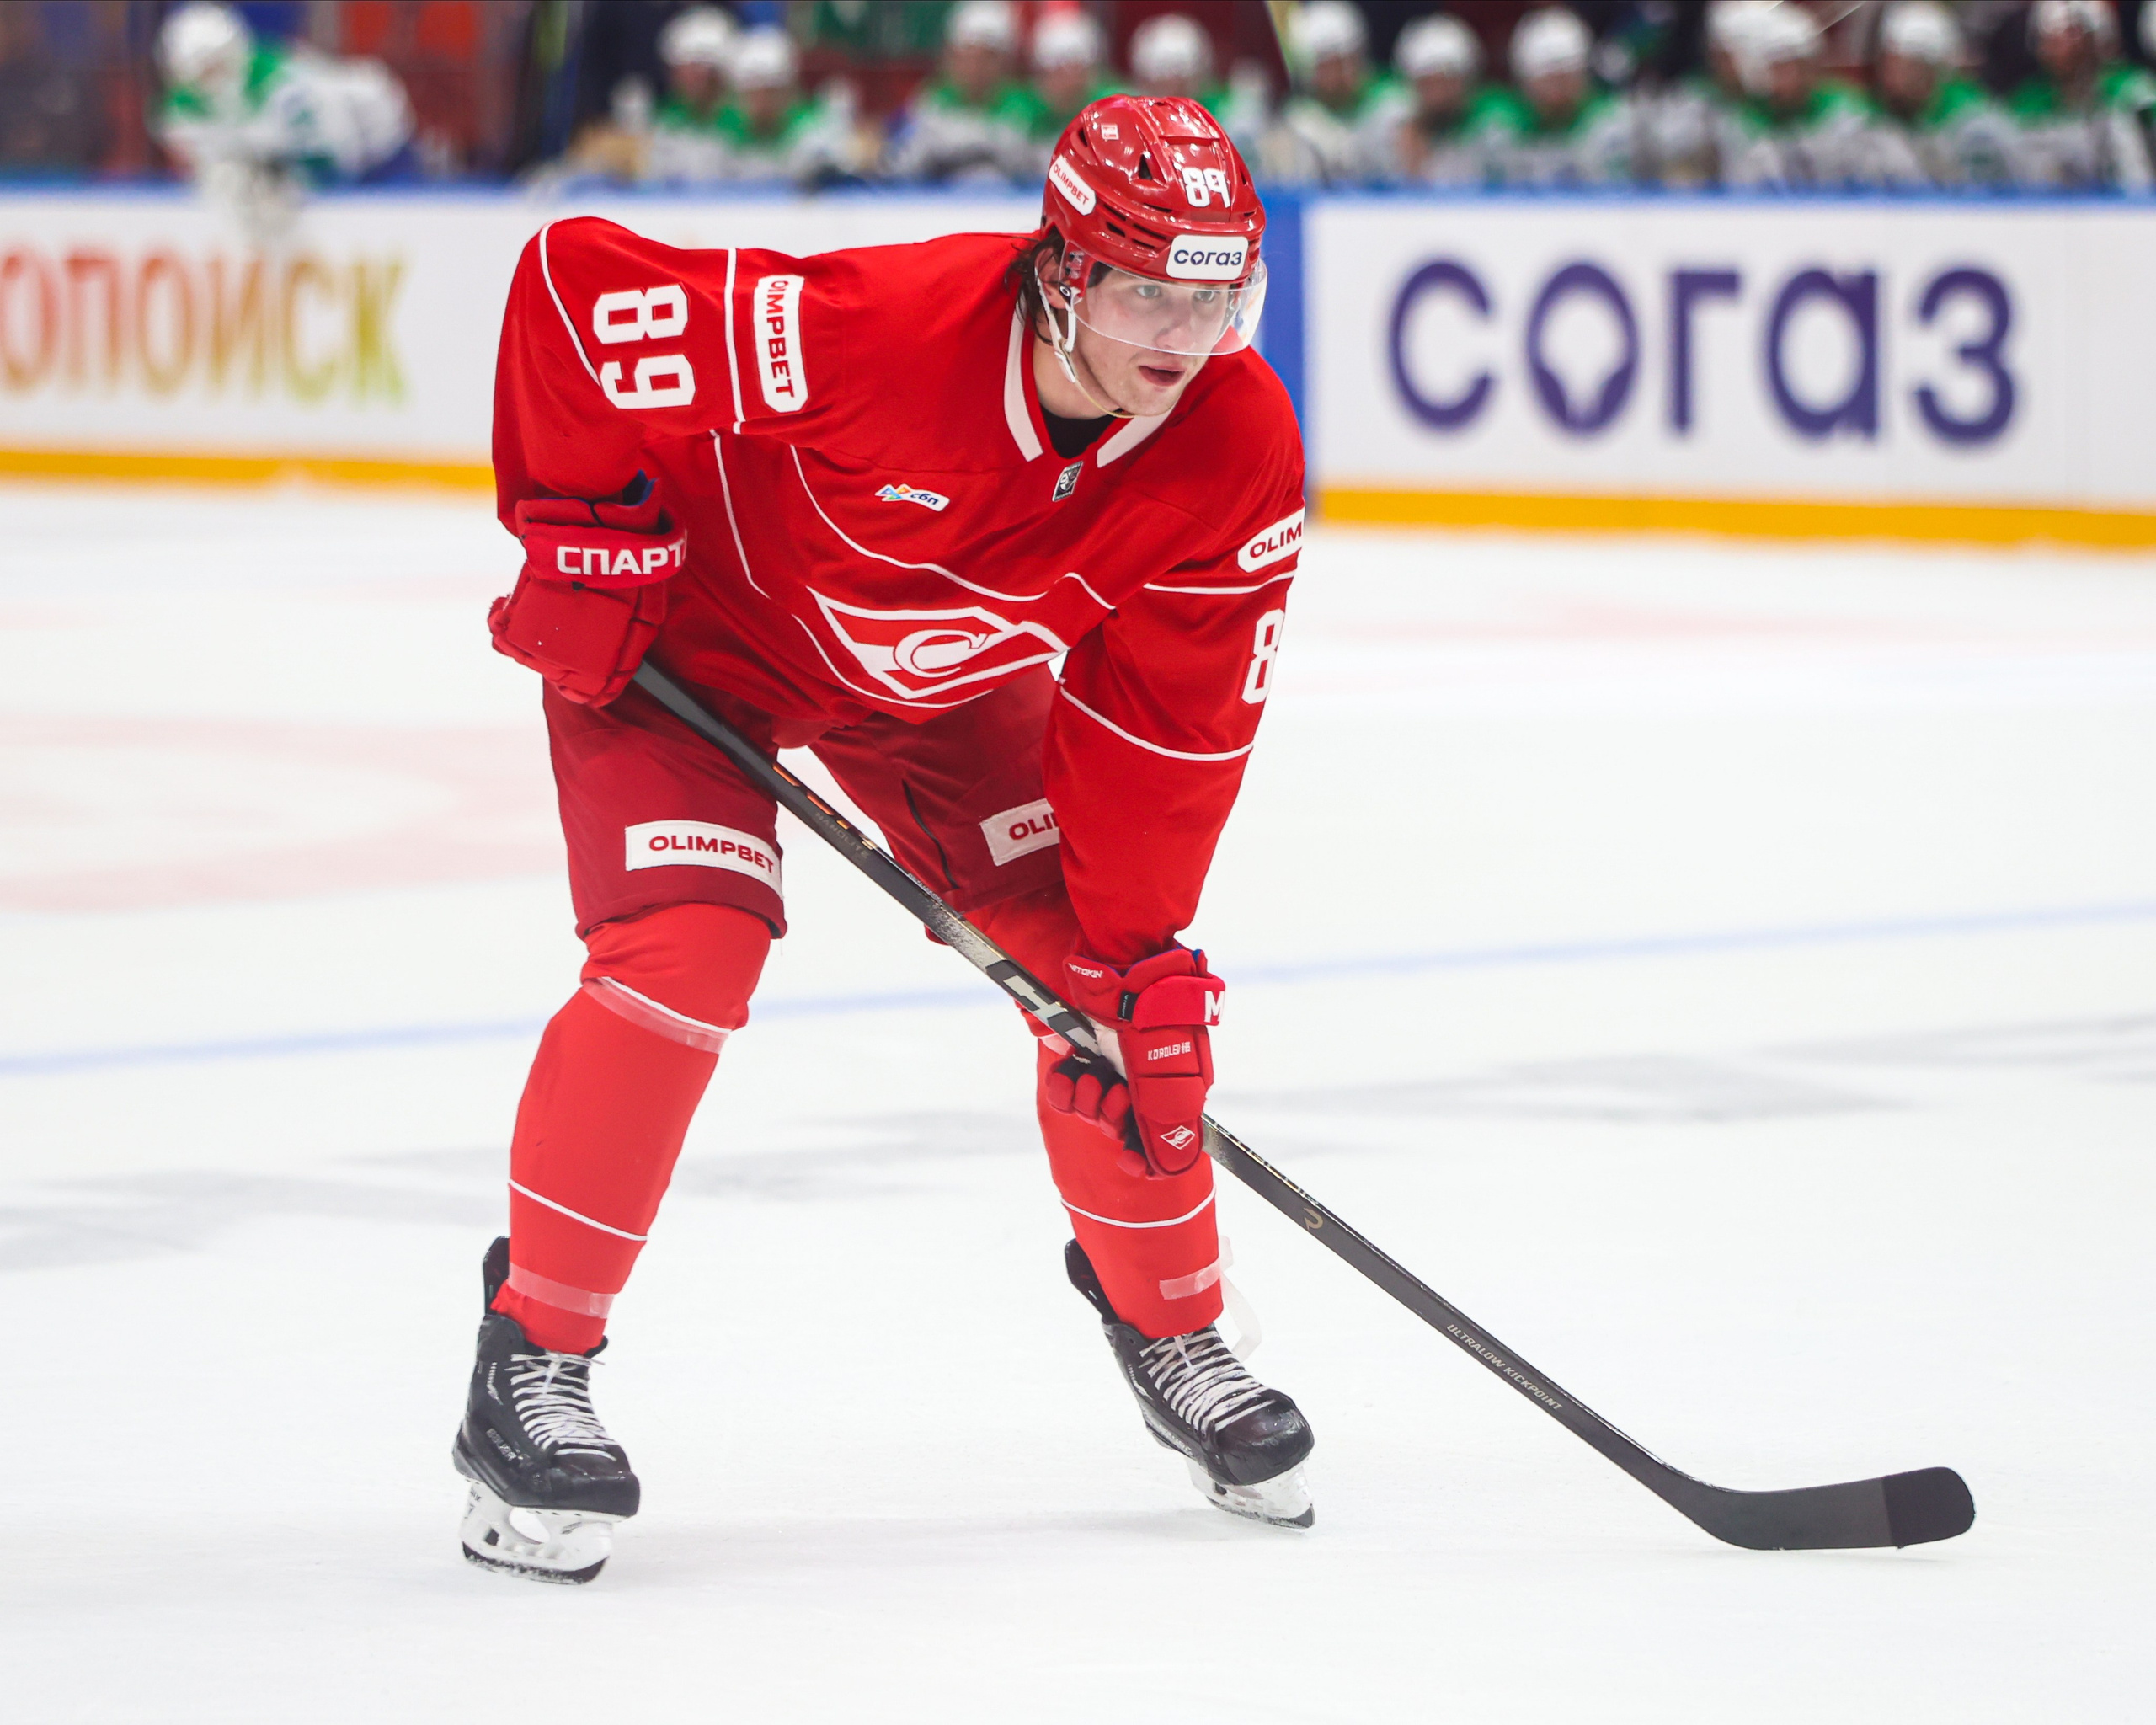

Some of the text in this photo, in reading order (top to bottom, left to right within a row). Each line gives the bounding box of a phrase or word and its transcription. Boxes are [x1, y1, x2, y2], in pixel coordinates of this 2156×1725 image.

[1054, 164, 1089, 205] OLIMPBET
[1182, 167, 1230, 208] 89
[593, 282, 696, 409] 89
[766, 280, 795, 398] OIMPBET
[557, 538, 687, 575] СПАРТ
[1250, 521, 1302, 558] OLIM
[1241, 608, 1286, 705] 8
[648, 835, 774, 874] OLIMPBET
[1446, 1323, 1563, 1411] ULTRALOW KICKPOINT
